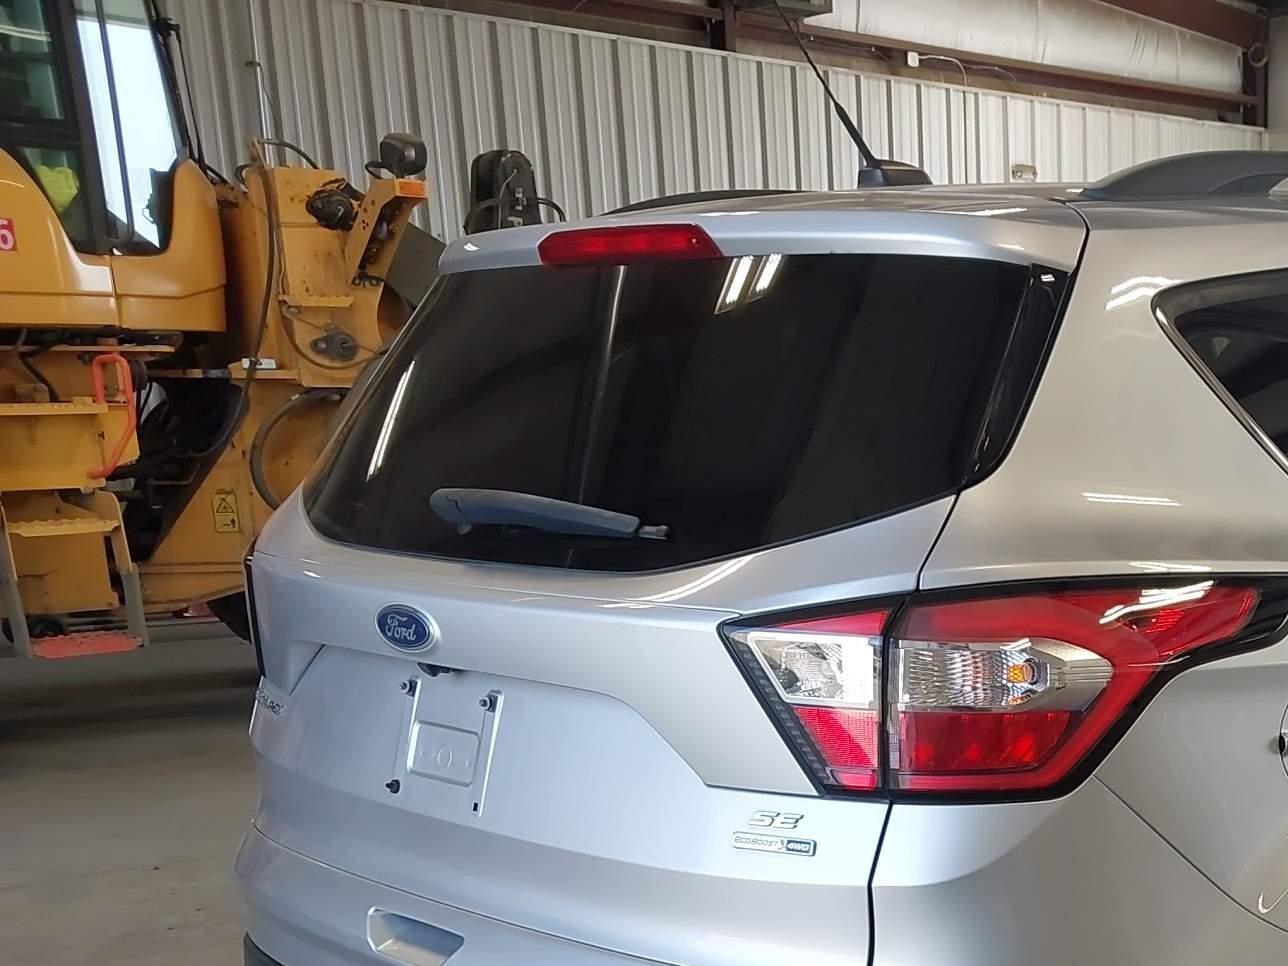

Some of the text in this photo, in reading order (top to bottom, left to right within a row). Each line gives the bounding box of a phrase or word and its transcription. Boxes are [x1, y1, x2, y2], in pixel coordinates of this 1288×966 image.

[386, 613, 416, 641] Ford
[749, 810, 804, 829] SE
[787, 842, 810, 851] 4WD
